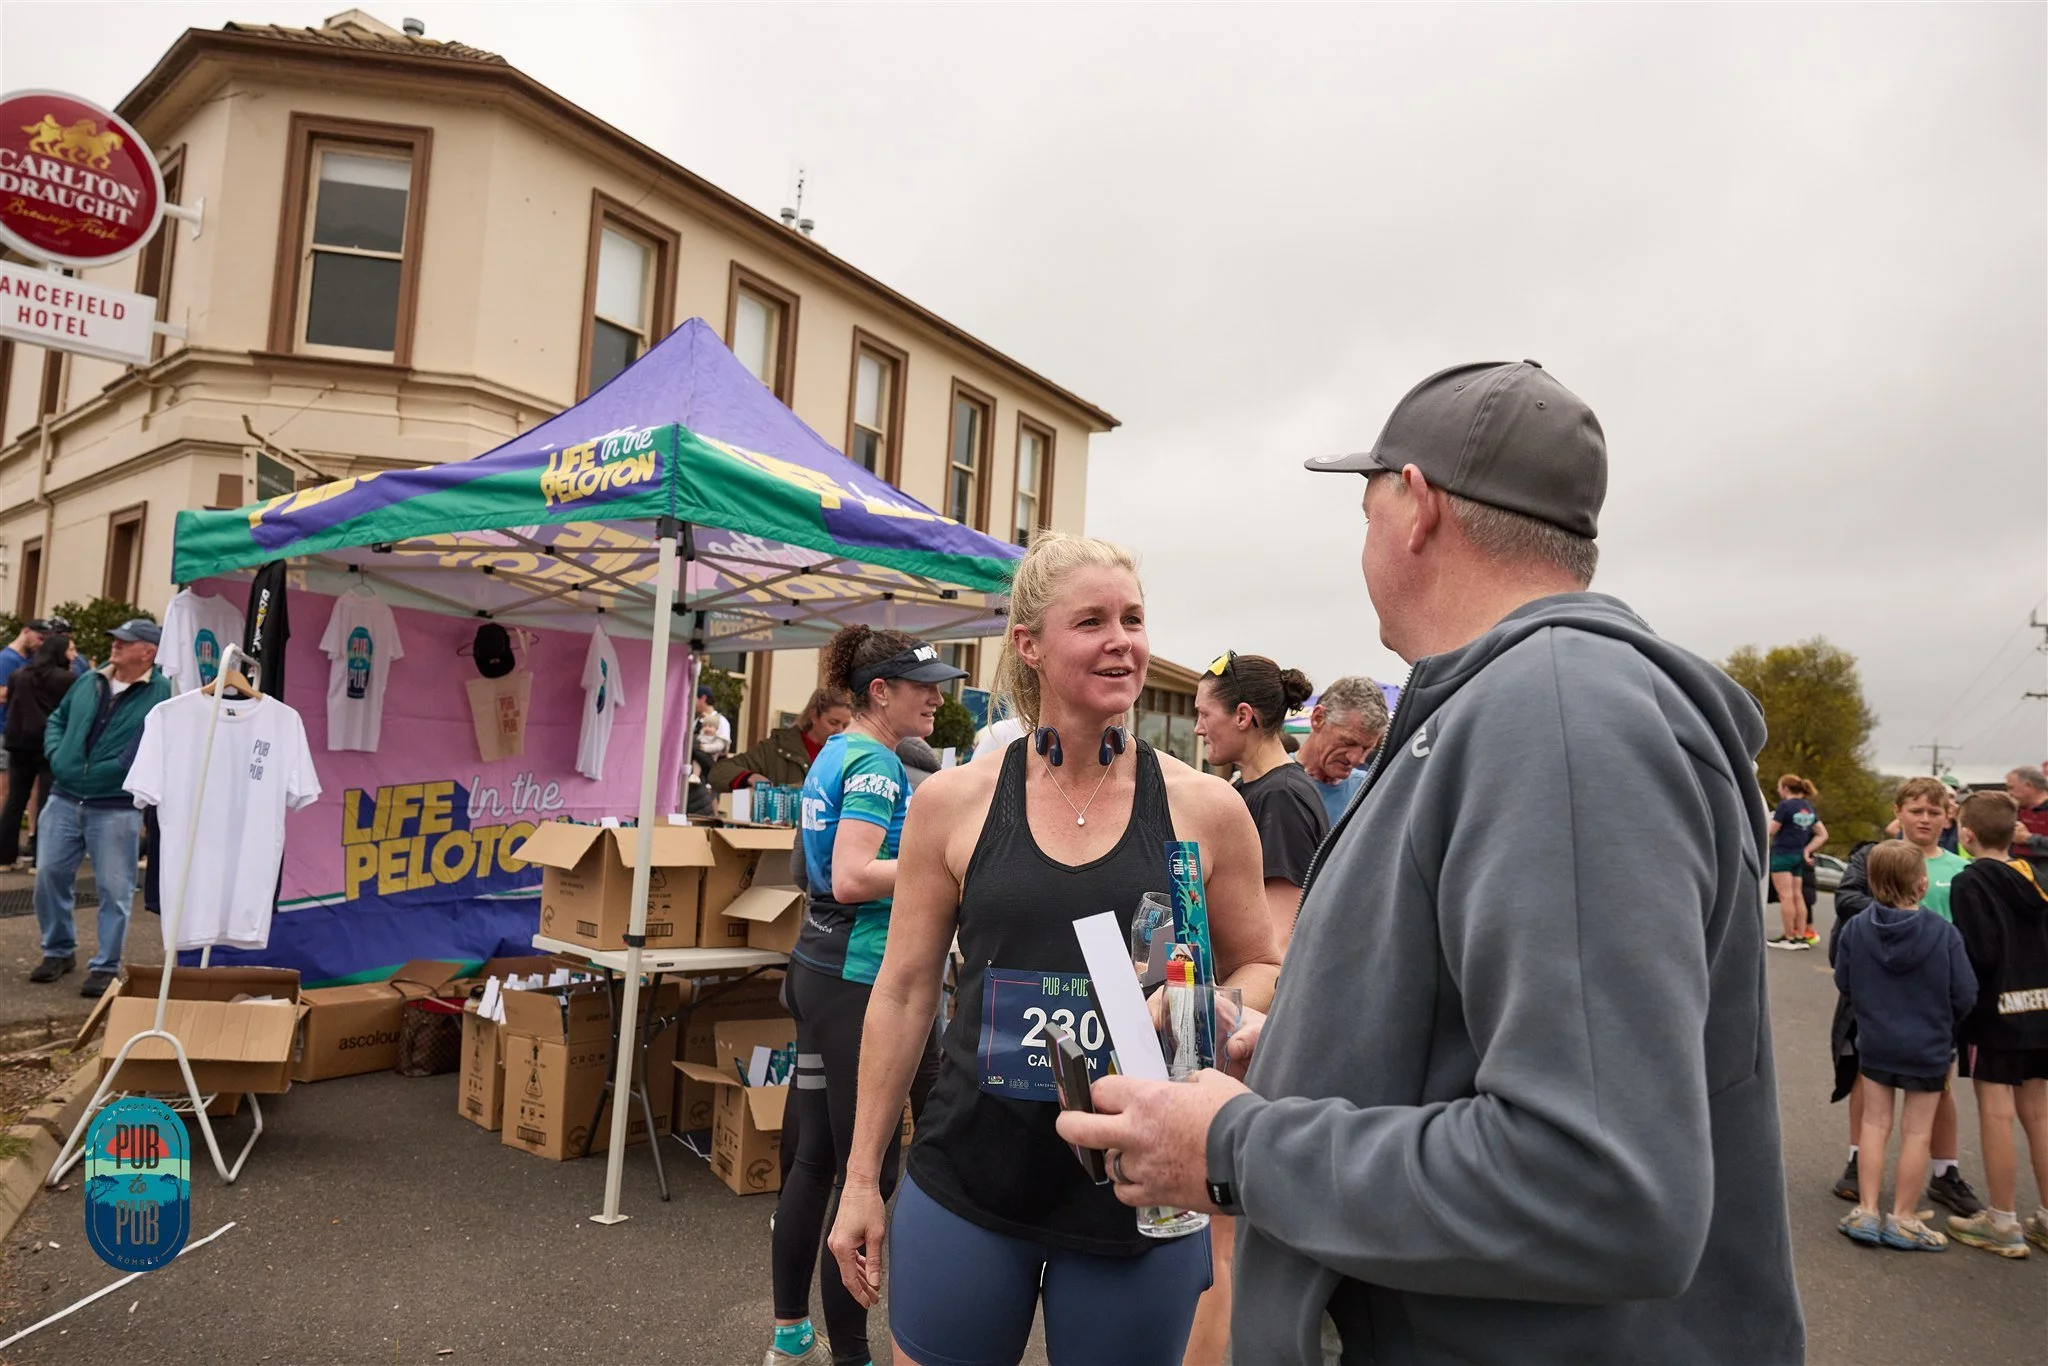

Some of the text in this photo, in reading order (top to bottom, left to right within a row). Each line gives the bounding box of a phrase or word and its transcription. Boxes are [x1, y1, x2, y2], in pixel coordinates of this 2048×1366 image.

[0, 148, 140, 208] CARLTON
[0, 171, 133, 226] DRAUGHT
[18, 305, 88, 337] HOTEL
[540, 450, 656, 507] PELOTON
[541, 440, 600, 478] LIFE
[253, 739, 271, 757] PUB
[249, 763, 264, 781] PUB
[342, 771, 565, 845] LIFE In the
[344, 818, 551, 901] PELOTO
[1042, 976, 1060, 996] PUB
[1021, 1007, 1105, 1051] 230
